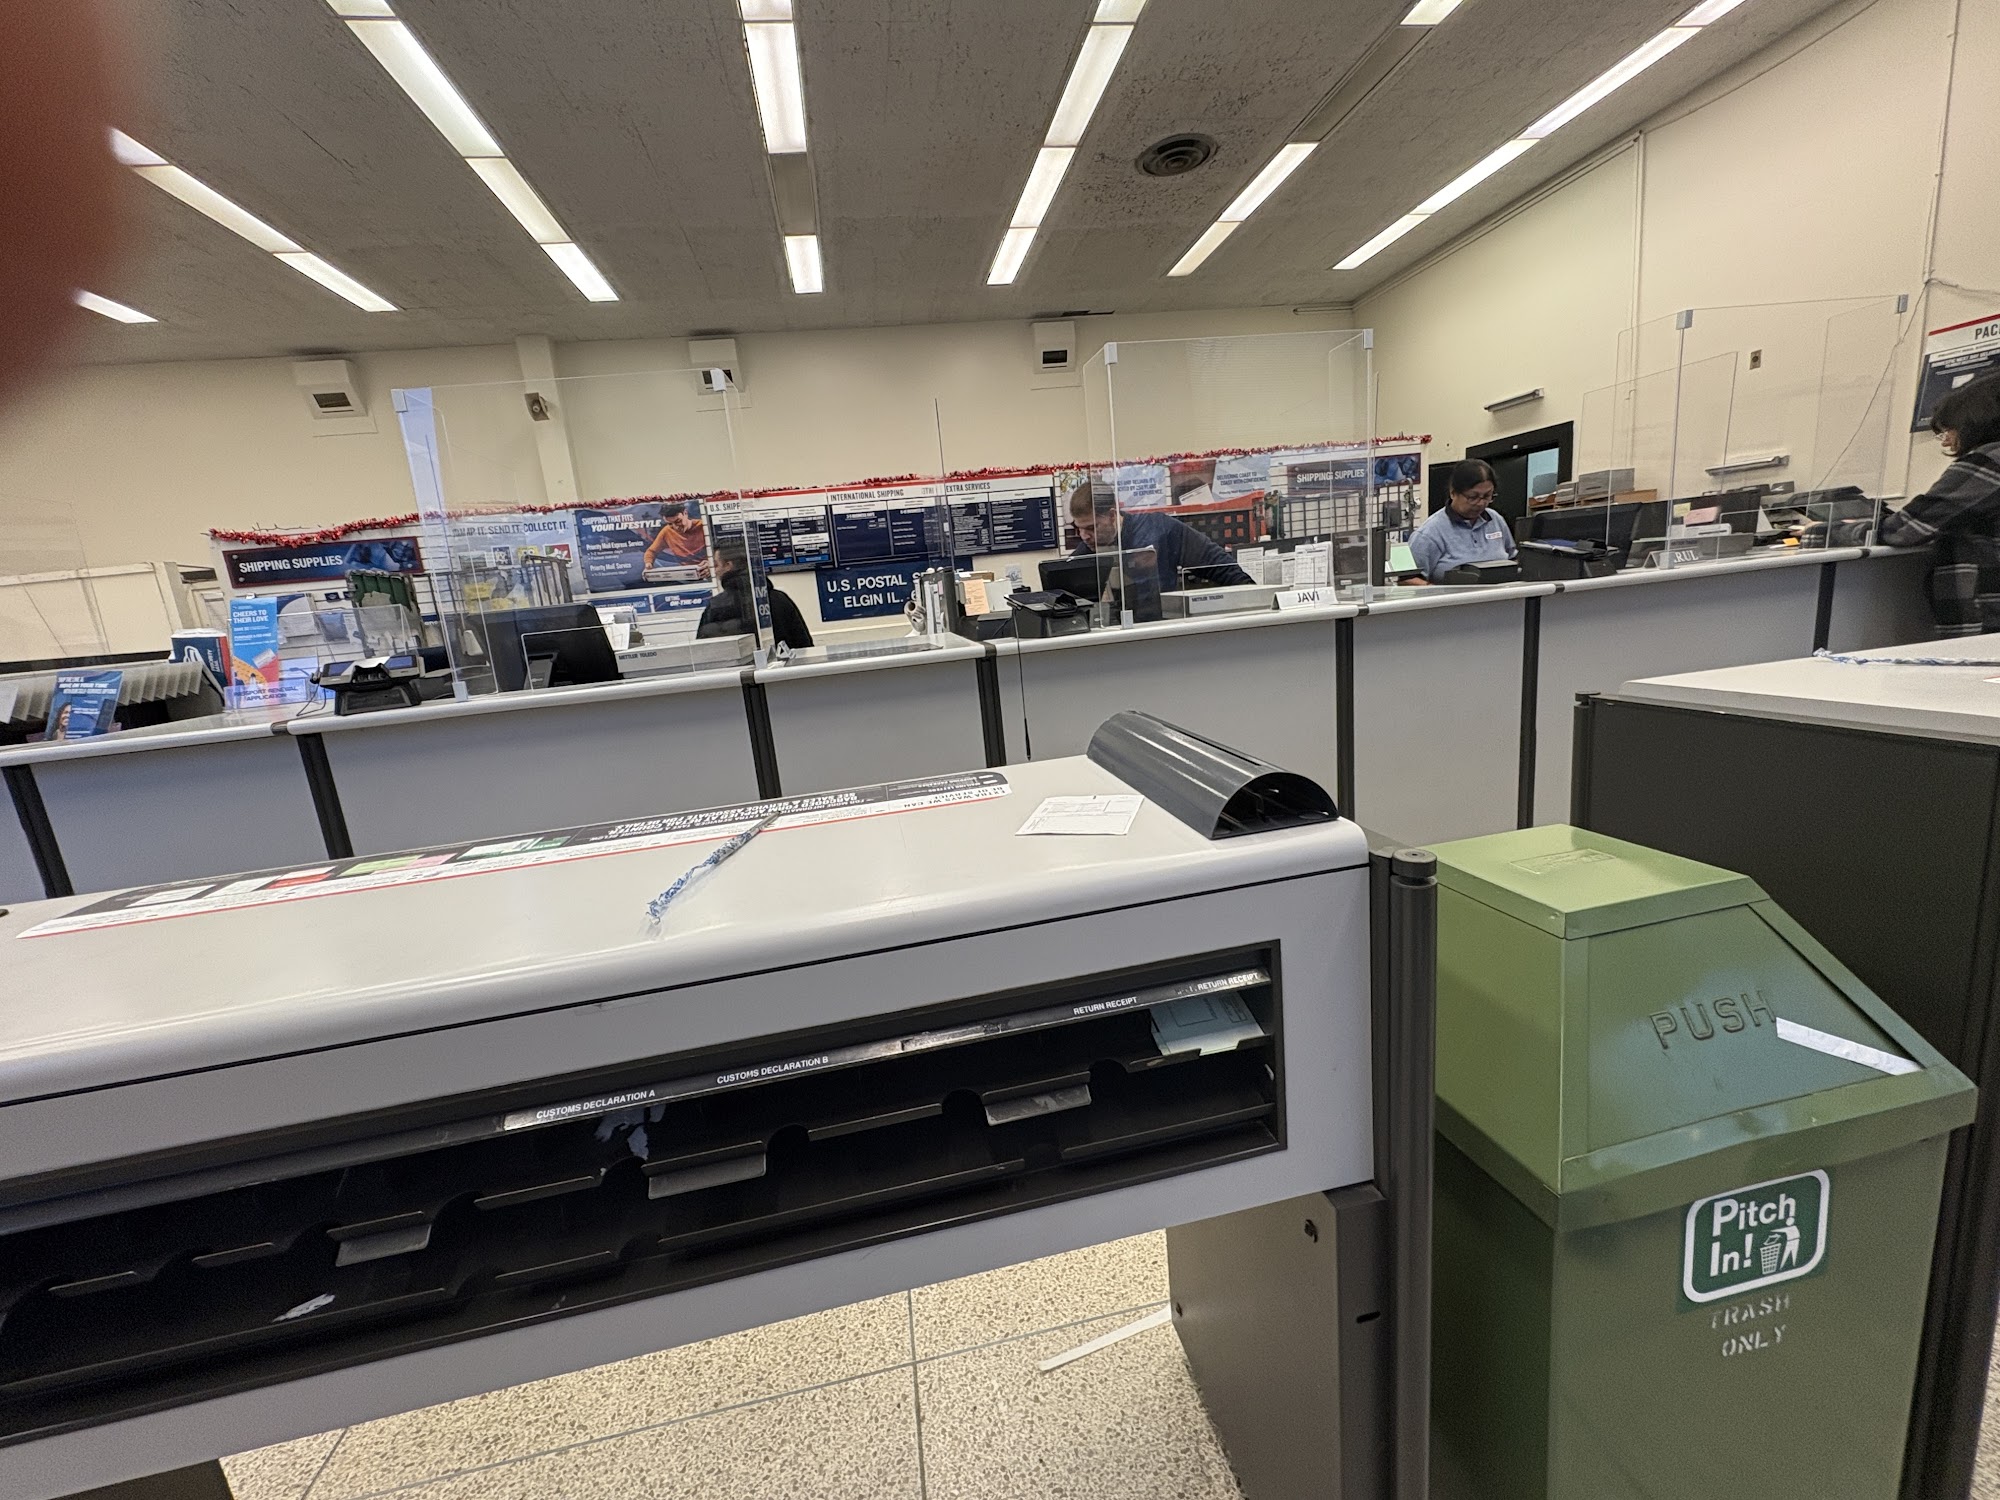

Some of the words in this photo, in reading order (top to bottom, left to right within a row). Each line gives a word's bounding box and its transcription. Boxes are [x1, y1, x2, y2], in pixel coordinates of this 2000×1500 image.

[1974, 323, 2000, 340] PAC
[1296, 472, 1334, 483] SHIPPING
[1334, 468, 1365, 480] SUPPLIES
[965, 482, 990, 491] SERVICES
[830, 491, 875, 501] INTERNATIONAL
[877, 489, 904, 498] SHIPPING
[524, 521, 557, 533] COLLECT
[559, 520, 569, 530] IT.
[582, 516, 607, 525] SHIPPING
[591, 523, 614, 532] YOUR
[615, 519, 661, 530] LIFESTYLE
[239, 560, 291, 574] SHIPPING
[292, 555, 343, 569] SUPPLIES
[1674, 550, 1699, 563] RUL
[857, 574, 907, 589] POSTAL
[844, 594, 883, 608] ELGIN
[233, 610, 258, 618] CHEERS
[252, 615, 269, 623] LOVE
[1198, 981, 1227, 990] RETURN
[1227, 973, 1258, 984] RECEIPT
[1073, 1003, 1105, 1015] RETURN
[1105, 997, 1137, 1009] RECEIPT
[1649, 990, 1777, 1050] PUSH
[717, 1069, 759, 1084] CUSTOMS
[760, 1057, 821, 1075] DECLARATION
[536, 1103, 581, 1119] CUSTOMS
[582, 1090, 648, 1109] DECLARATION
[648, 1089, 656, 1097] A
[1712, 1193, 1796, 1237] Pitch
[1710, 1233, 1753, 1277] In!
[1711, 1294, 1790, 1328] TRASH
[1722, 1324, 1787, 1357] ONLY
